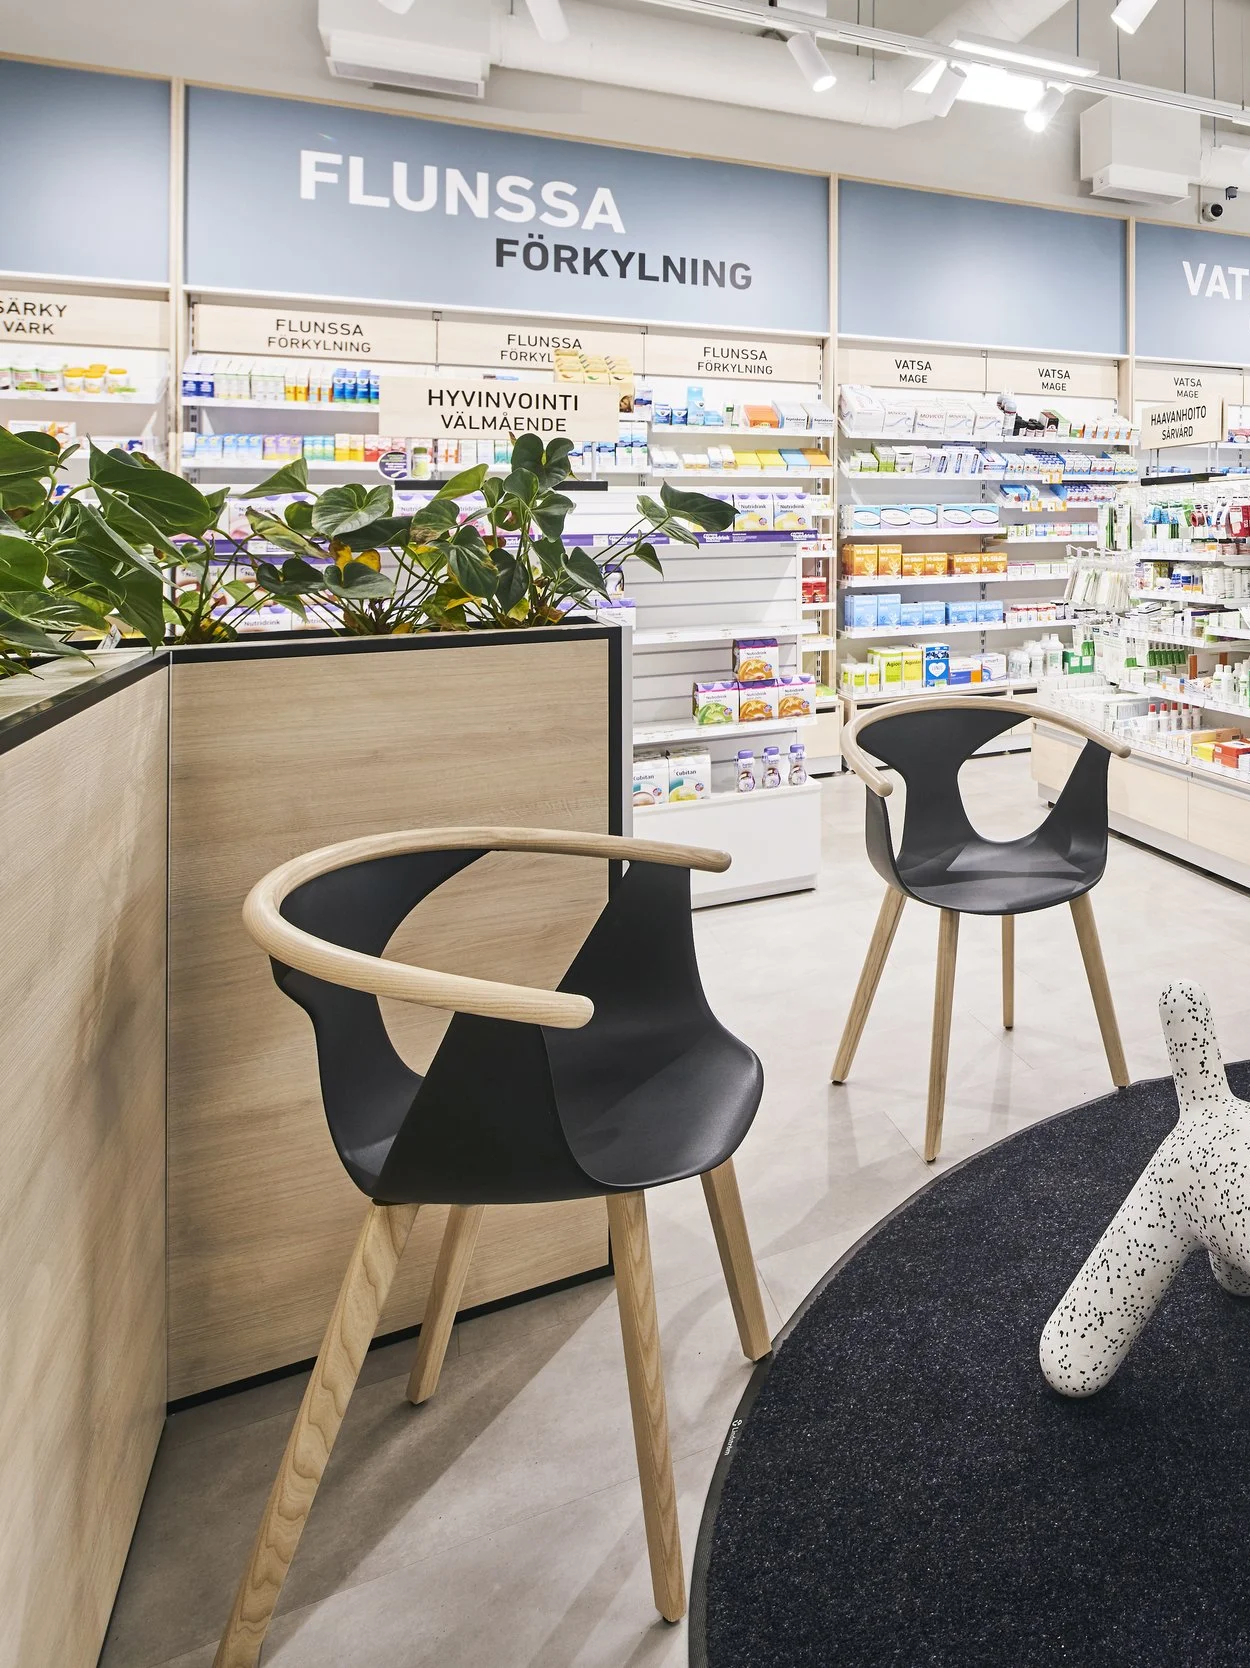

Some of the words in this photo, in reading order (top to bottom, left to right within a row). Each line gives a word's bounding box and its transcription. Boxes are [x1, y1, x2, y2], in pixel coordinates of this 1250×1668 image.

[300, 150, 626, 234] FLUNSSA
[496, 232, 752, 290] FÖRKYLNING
[3, 318, 55, 335] VÄRK
[276, 319, 364, 337] FLUNSSA
[268, 335, 372, 353] FÖRKYLNING
[508, 333, 582, 350] FLUNSSA
[501, 350, 555, 363] FÖRKYL
[703, 346, 768, 361] FLUNSSA
[697, 360, 773, 375] FÖRKYLNING
[895, 359, 932, 371] VATSA
[899, 374, 928, 384] MAGE
[1038, 368, 1071, 380] VATSA
[1041, 382, 1067, 392] MAGE
[1173, 377, 1202, 388] VATSA
[428, 389, 578, 411] HYVINVOINTI
[1176, 389, 1199, 399] MAGE
[441, 411, 567, 433] VÄLMÅENDE
[1151, 405, 1207, 427] HAAVANHOITO
[1162, 424, 1194, 441] SÅRVÅRD
[675, 768, 697, 777] Cubitan
